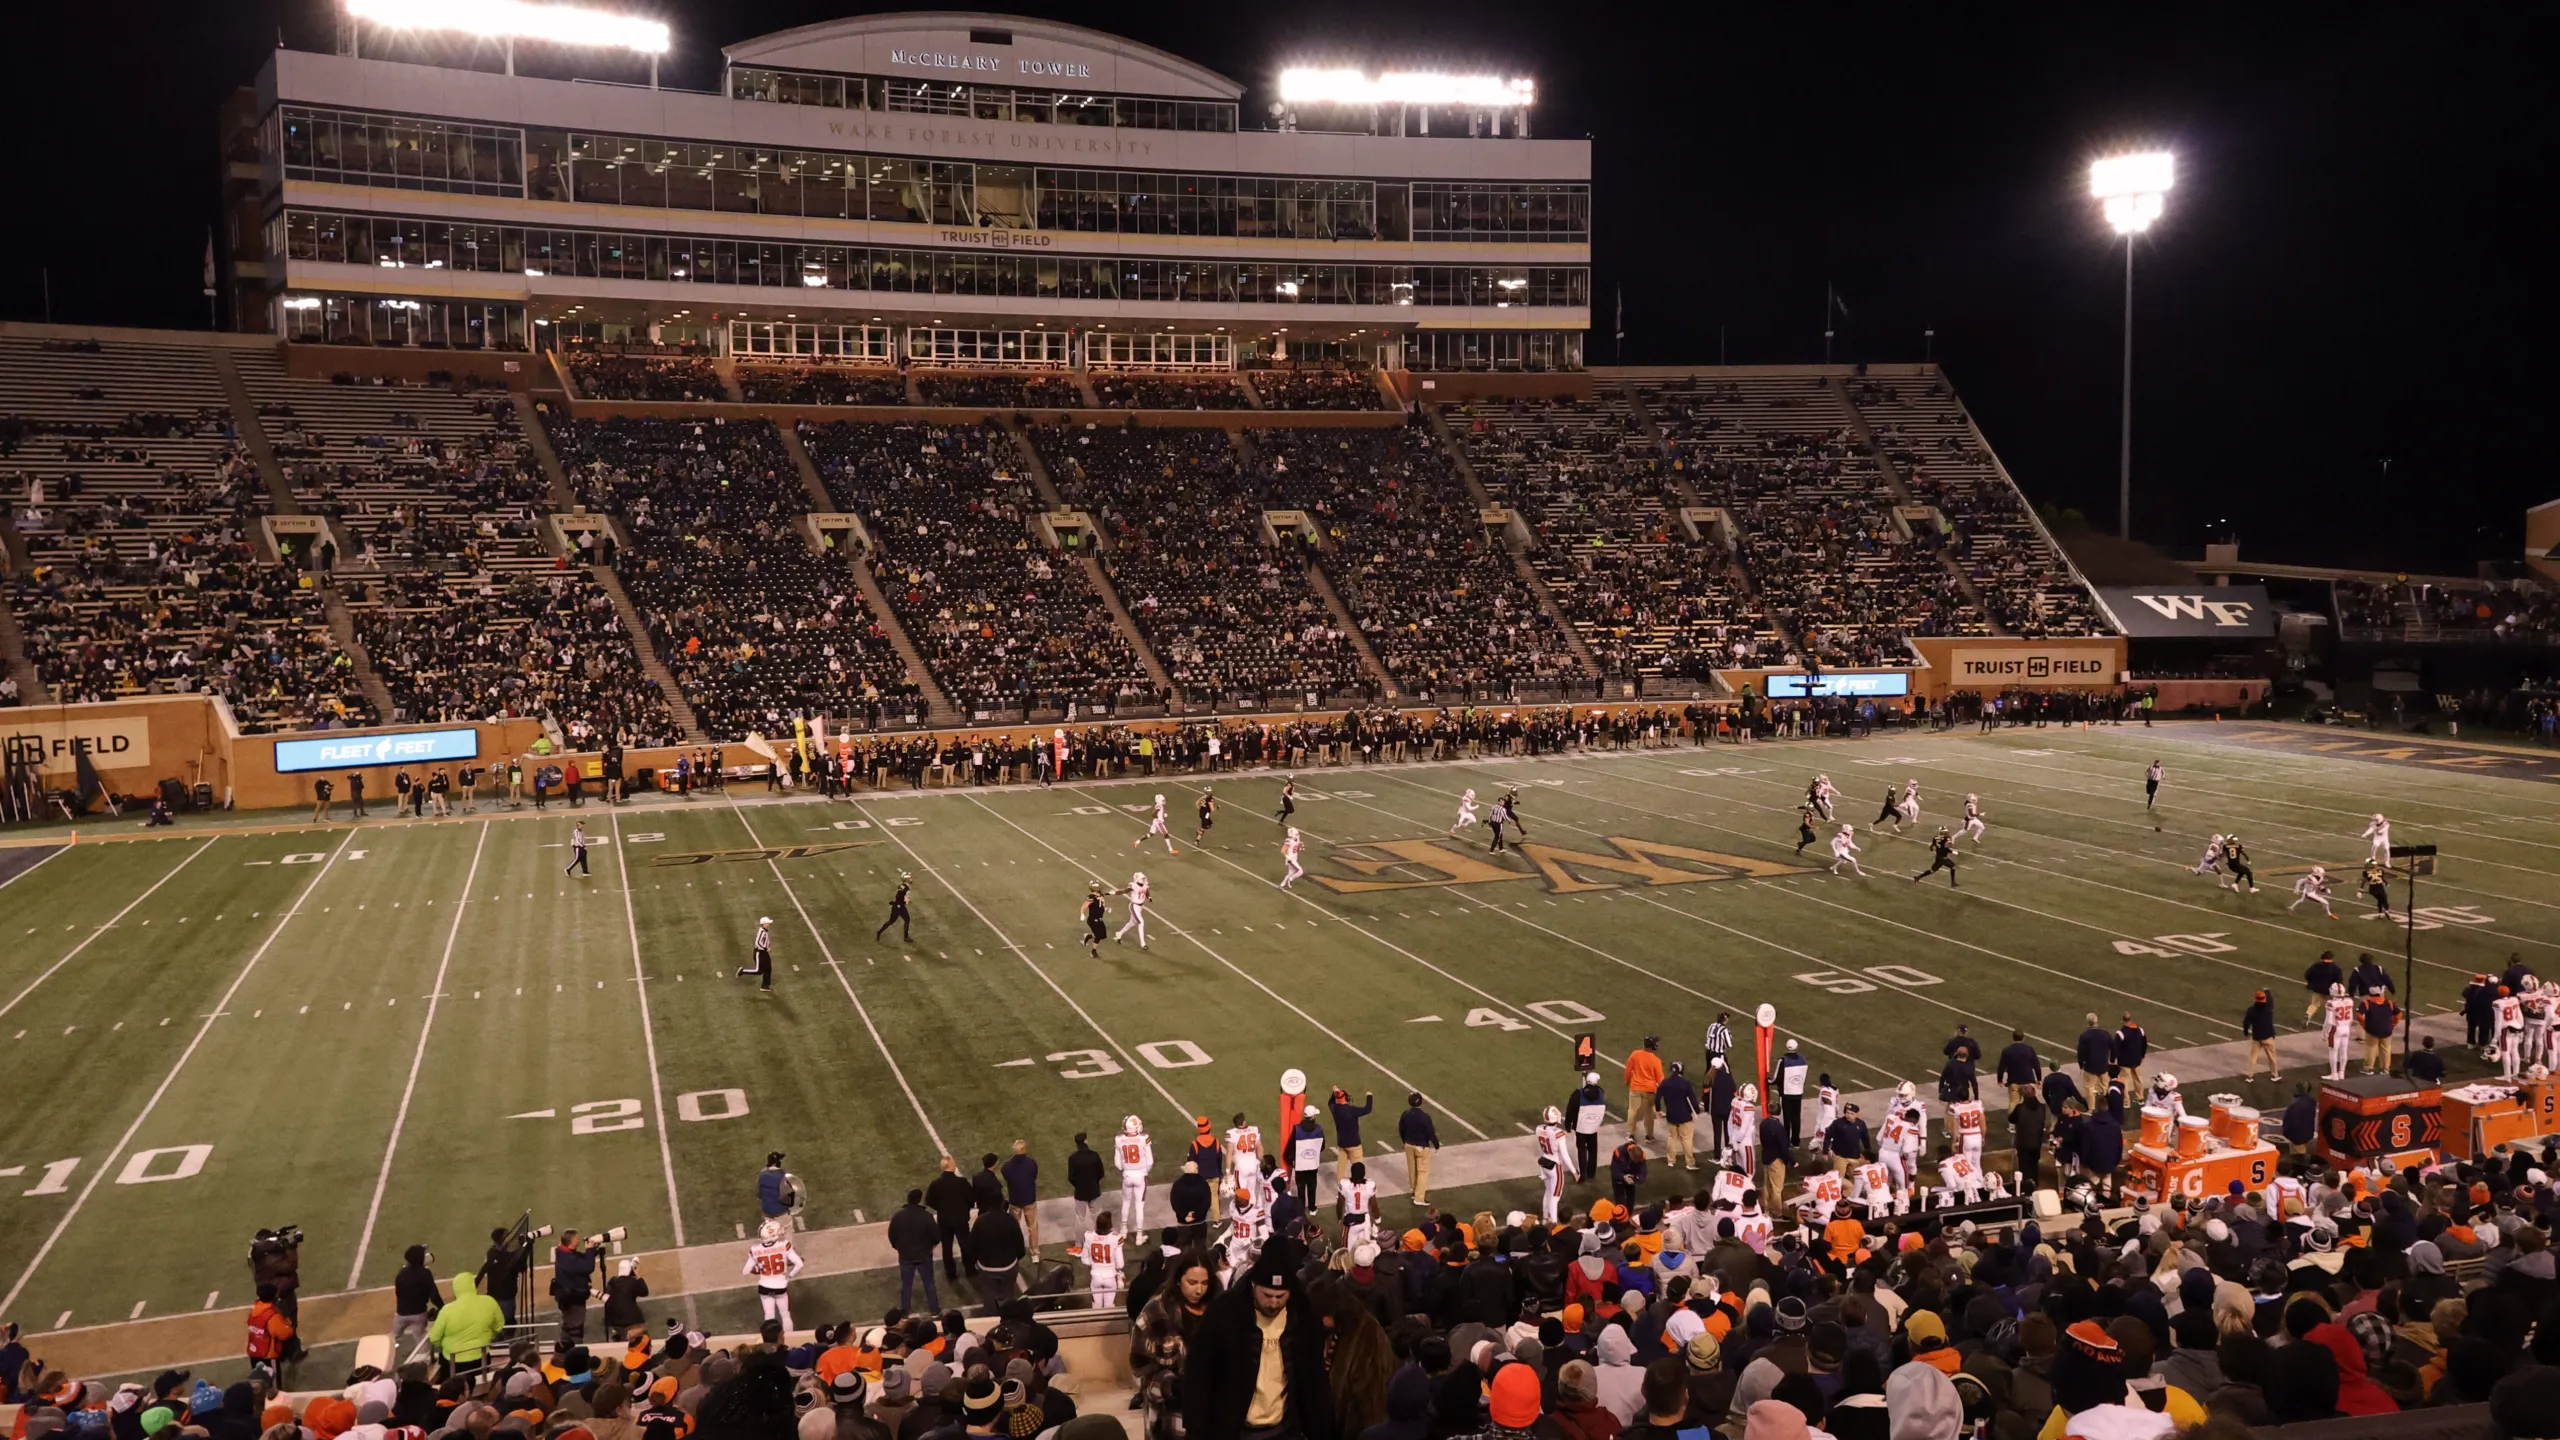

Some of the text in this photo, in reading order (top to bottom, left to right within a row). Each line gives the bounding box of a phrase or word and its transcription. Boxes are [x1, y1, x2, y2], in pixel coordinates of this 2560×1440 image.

[891, 50, 1091, 78] McCREARY TOWER
[829, 122, 1153, 155] WAKE FOREST UNIVERSITY
[941, 231, 1050, 246] TRUIST FIELD
[2132, 594, 2254, 628] WF
[1964, 659, 2102, 675] TRUIST FIELD
[1848, 679, 1879, 690] FEET
[52, 735, 130, 757] FIELD
[320, 739, 435, 760] FLEET FEET
[1791, 964, 1945, 994] 50
[1464, 1000, 1607, 1032] 40
[2335, 1006, 2352, 1021] 32
[1578, 1036, 1593, 1056] 4
[1045, 1040, 1214, 1079] 30
[571, 1087, 750, 1135] 20
[2544, 1095, 2555, 1114] S
[2390, 1114, 2412, 1148] S
[1122, 1144, 1140, 1164] 18
[22, 1144, 214, 1197] 10
[1726, 1172, 1744, 1189] 16
[2143, 1169, 2157, 1191] G
[2251, 1160, 2265, 1185] S
[1816, 1179, 1841, 1203] 45
[2182, 1167, 2204, 1198] G
[1353, 1191, 1361, 1211] 1
[756, 1253, 785, 1276] 36
